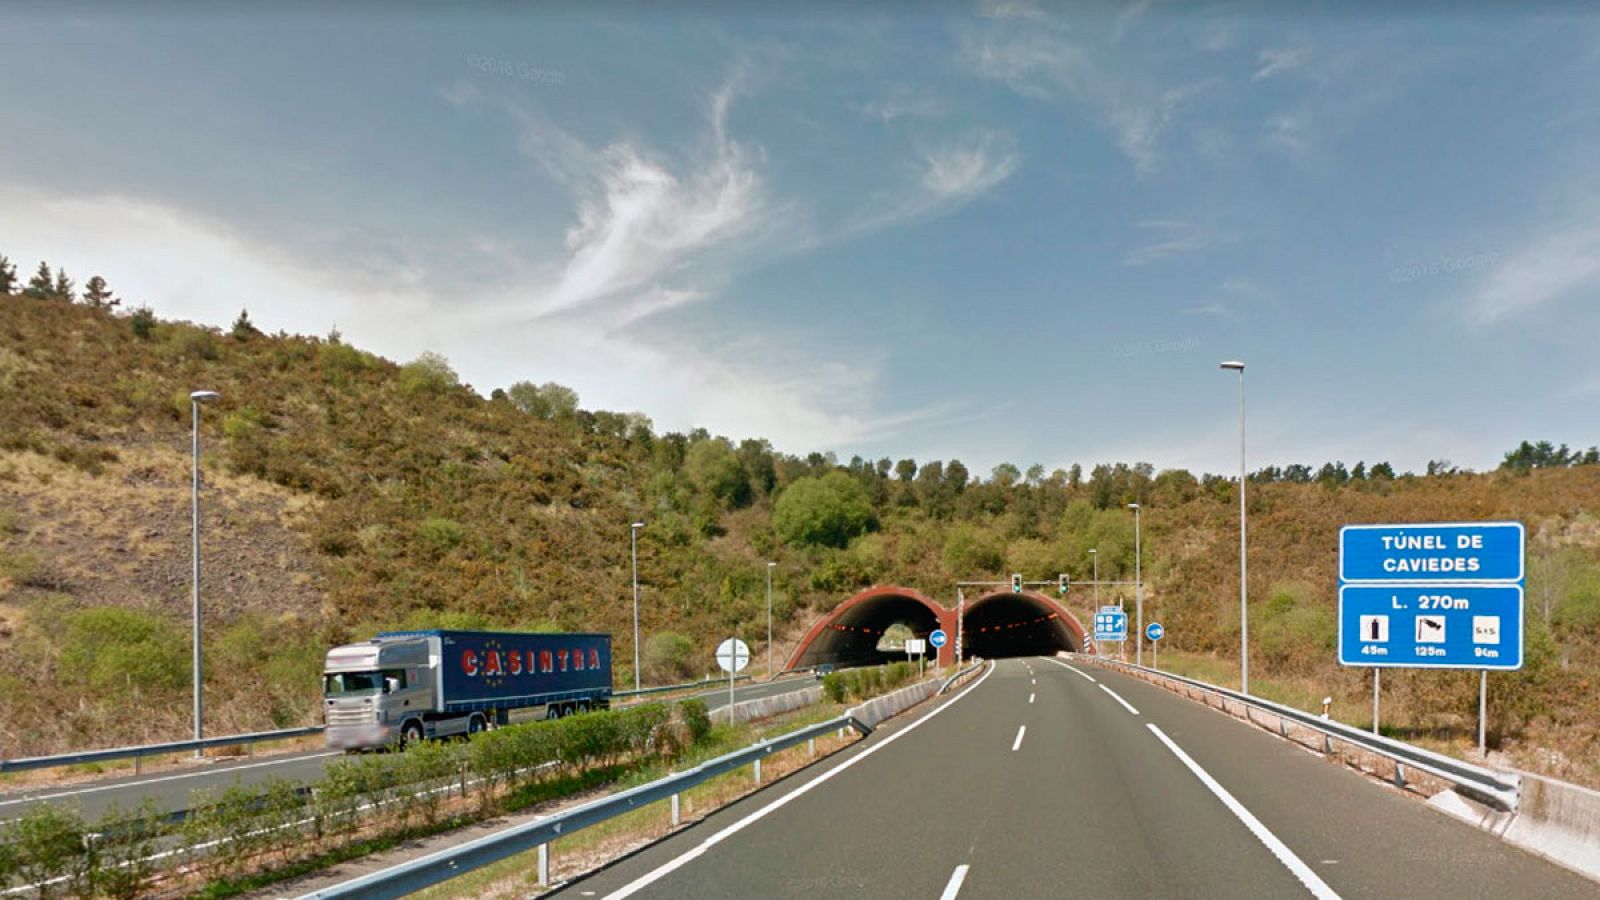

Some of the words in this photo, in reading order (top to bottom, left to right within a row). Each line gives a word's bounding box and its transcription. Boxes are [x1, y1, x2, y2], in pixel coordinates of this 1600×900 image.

[1381, 531, 1447, 550] TÚNEL
[1456, 535, 1483, 549] DE
[1383, 557, 1481, 572] CAVIEDES
[1391, 595, 1408, 609] L.
[1418, 595, 1469, 609] 270m
[1361, 644, 1388, 656] 45m
[1414, 645, 1446, 657] 125m
[462, 649, 600, 676] CASINTRA
